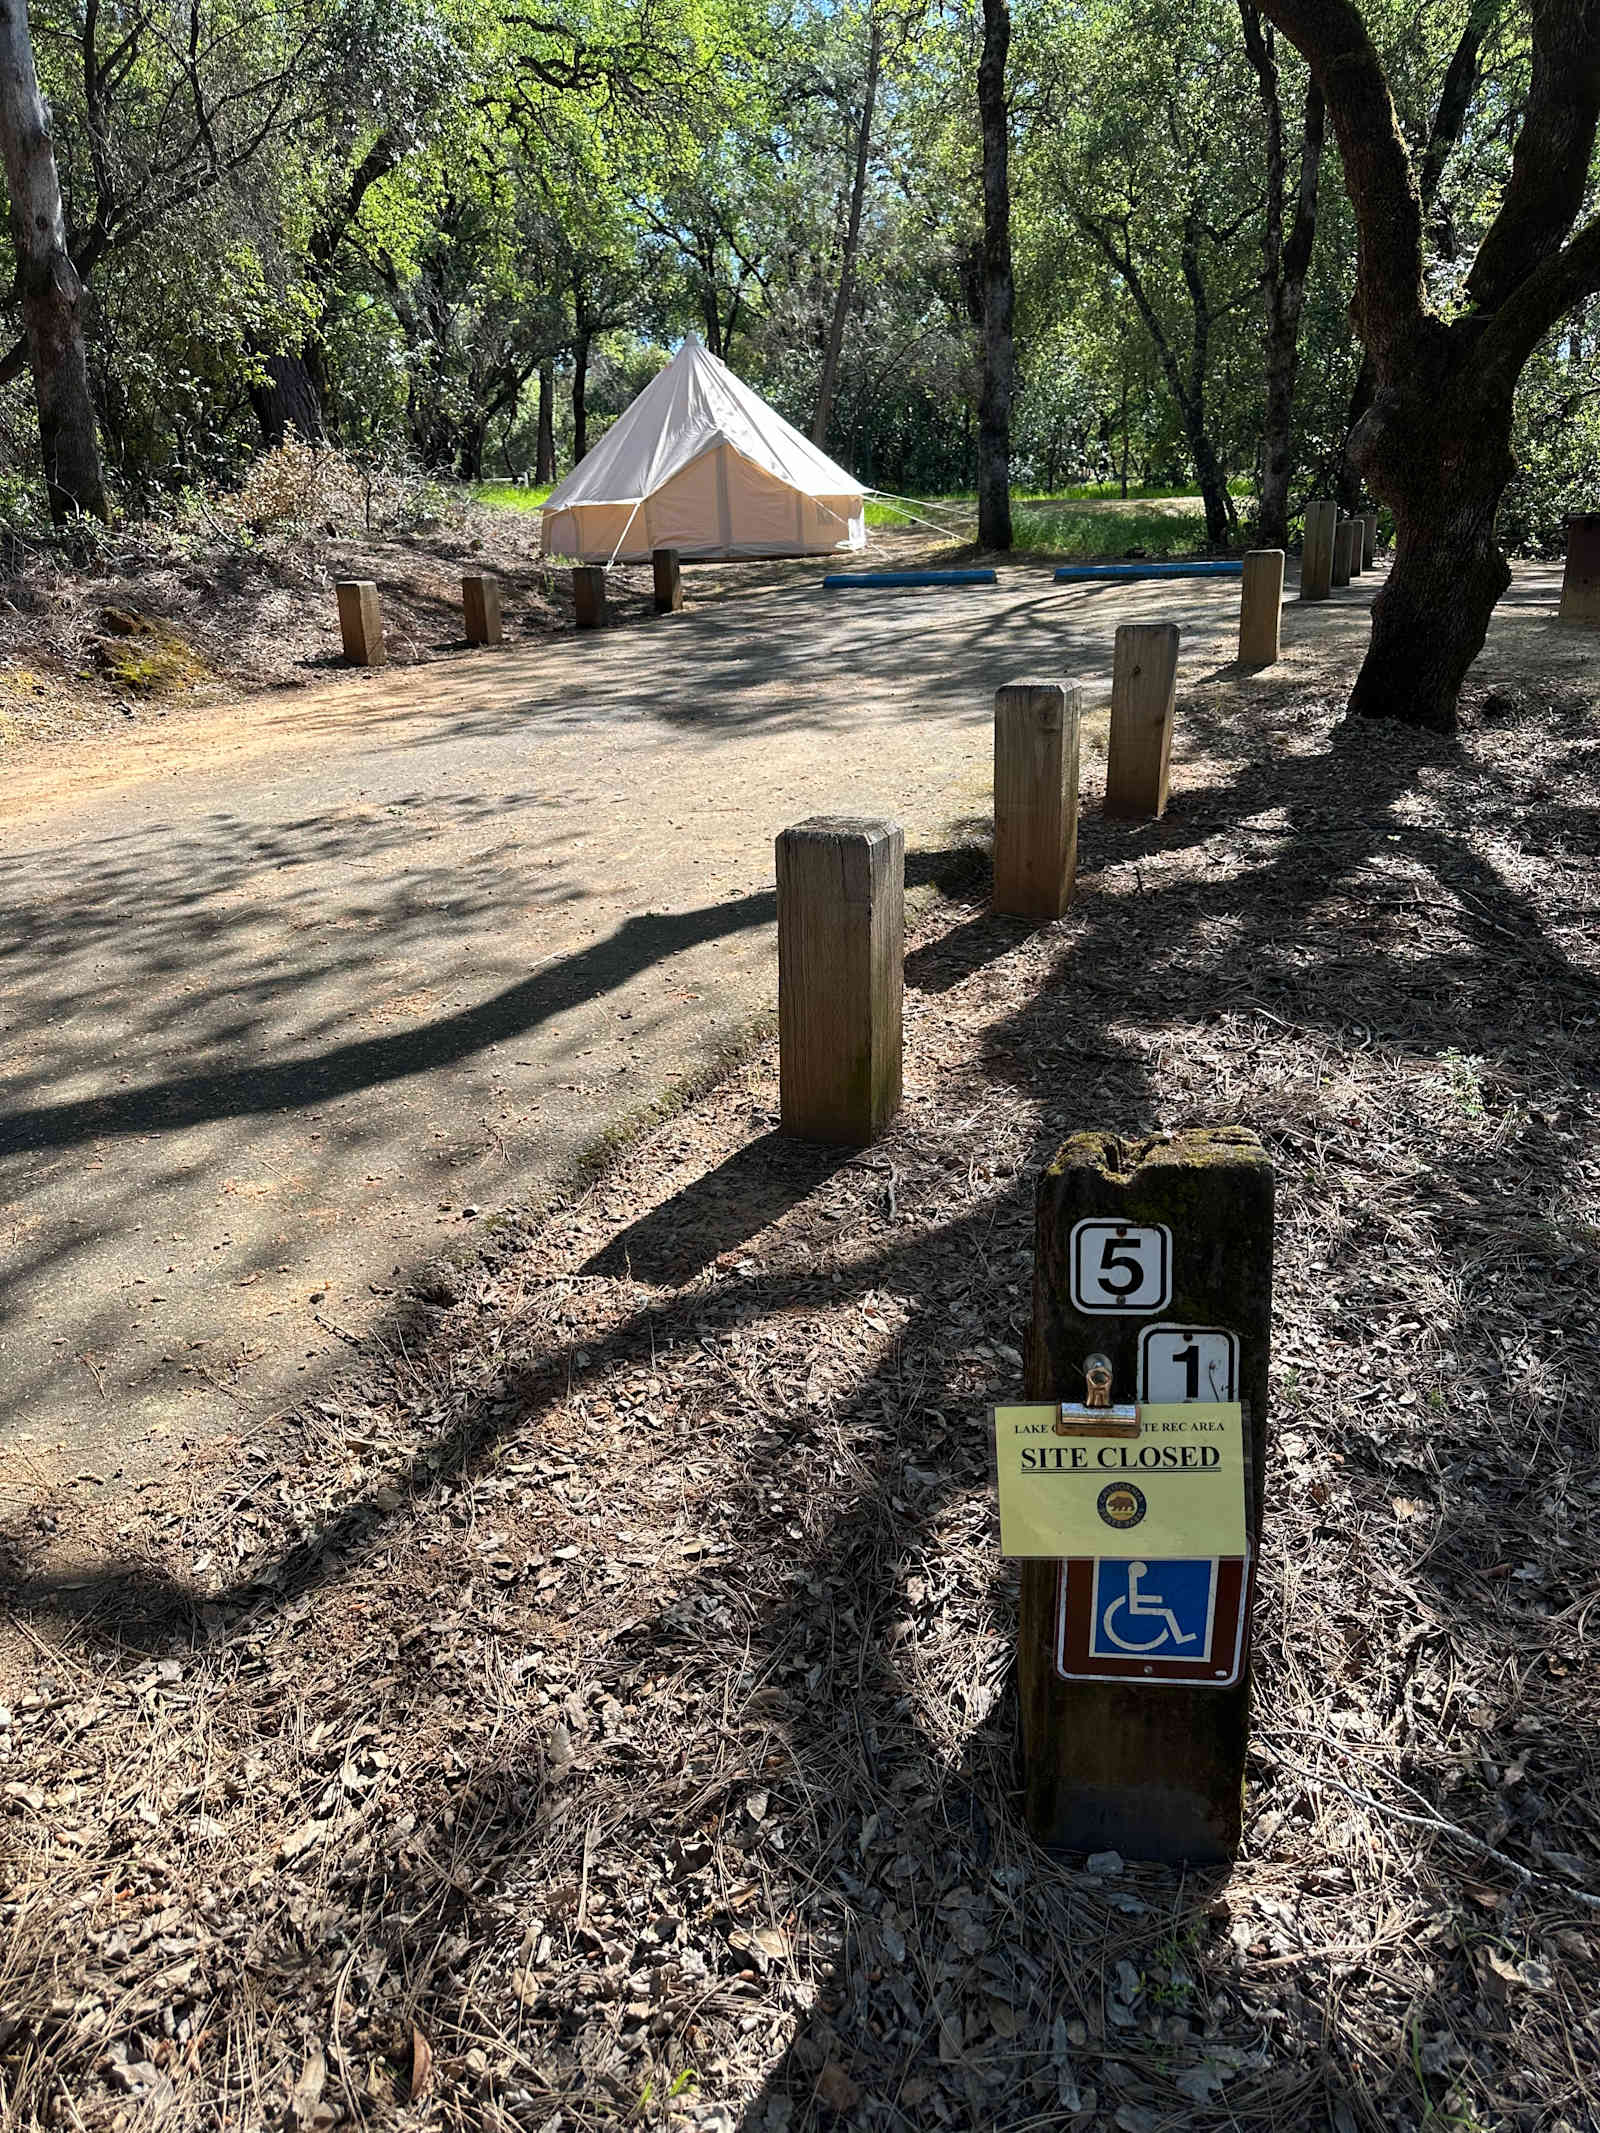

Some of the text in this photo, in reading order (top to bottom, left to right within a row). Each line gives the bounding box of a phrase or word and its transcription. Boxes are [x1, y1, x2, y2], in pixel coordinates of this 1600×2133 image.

[1097, 1238, 1144, 1296] 5
[1172, 1345, 1199, 1398] 1
[1015, 1424, 1048, 1434] LAKE
[1162, 1422, 1187, 1432] REC
[1190, 1422, 1225, 1432] AREA
[1021, 1446, 1221, 1469] SITE CLOSED
